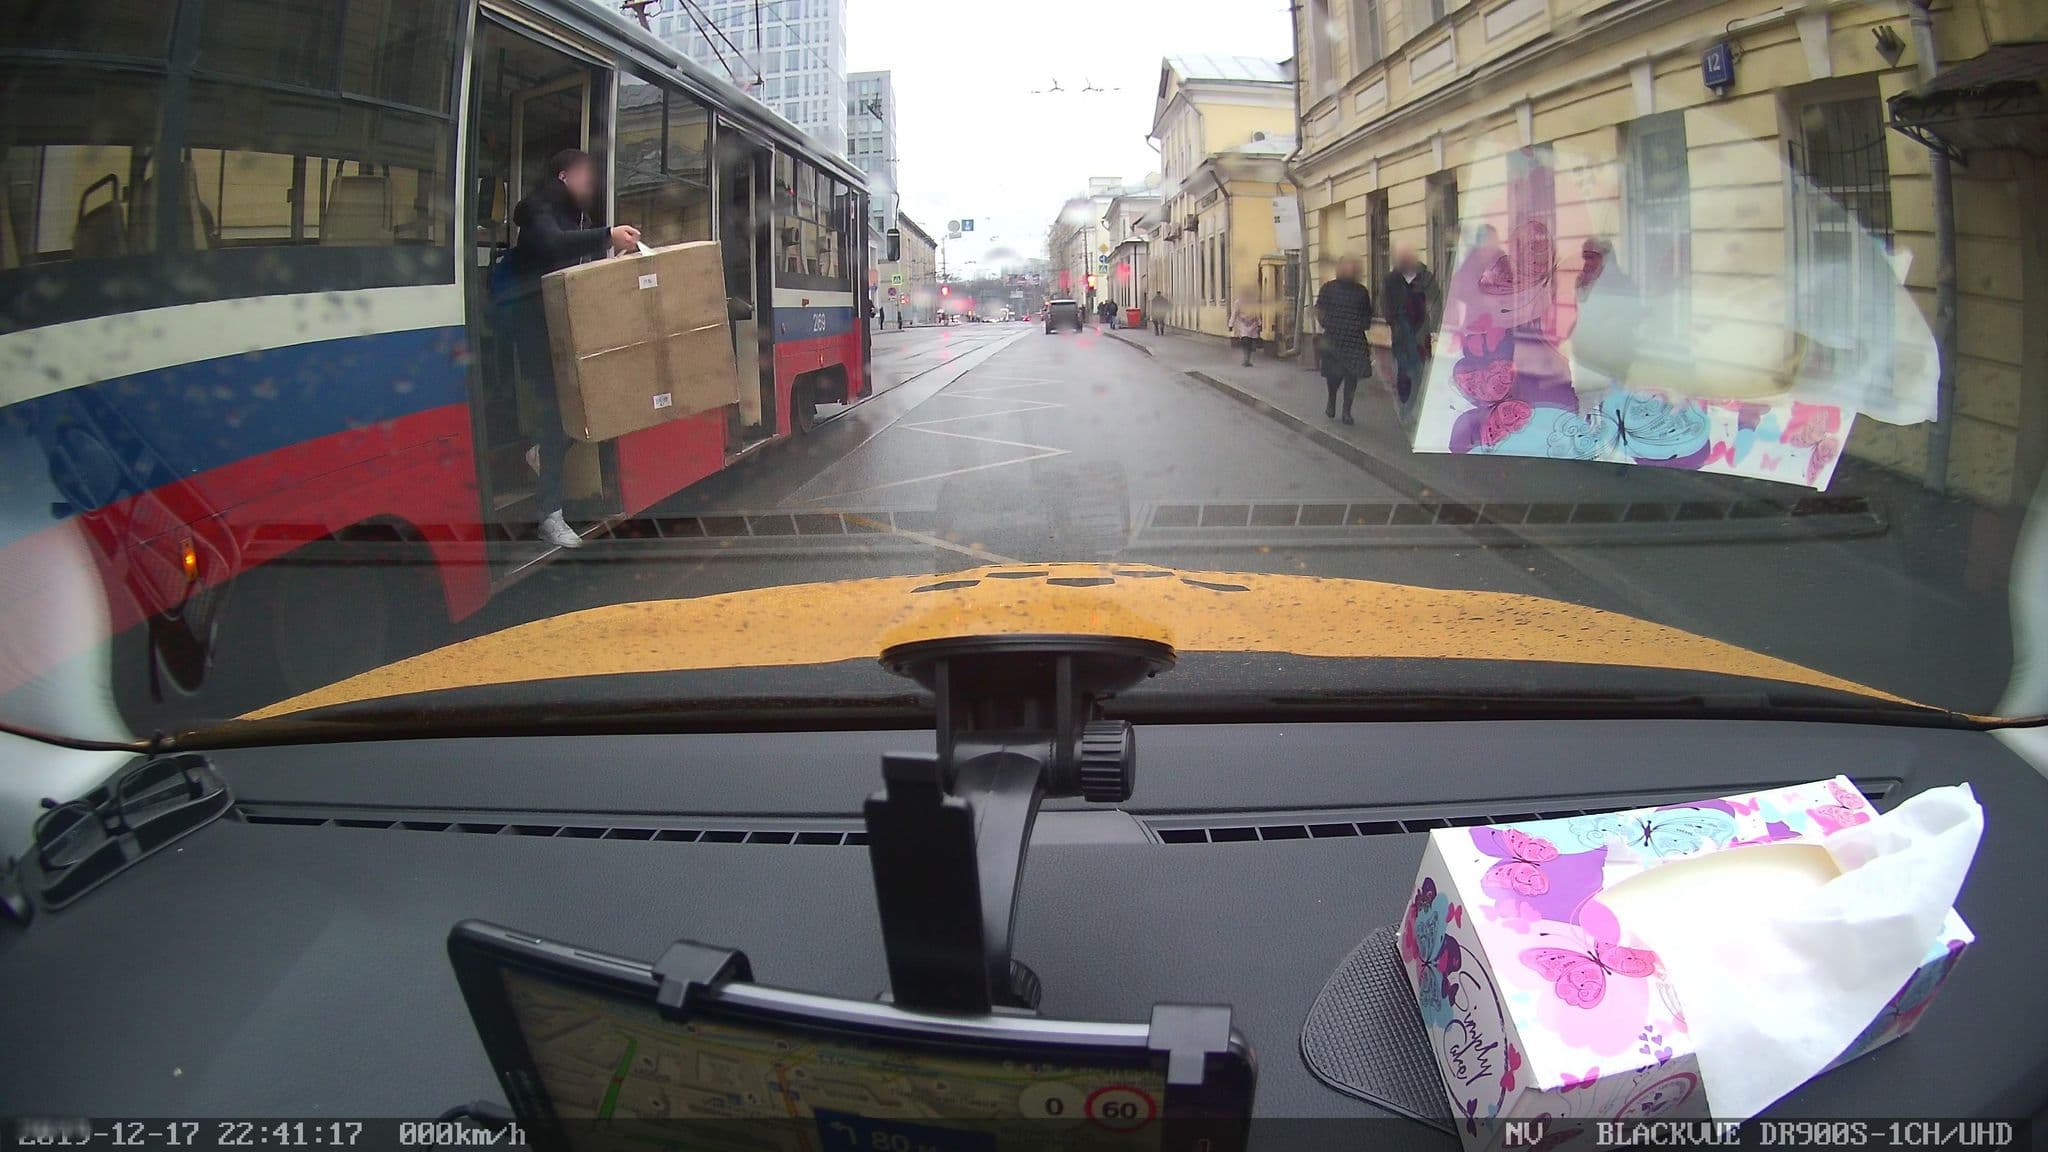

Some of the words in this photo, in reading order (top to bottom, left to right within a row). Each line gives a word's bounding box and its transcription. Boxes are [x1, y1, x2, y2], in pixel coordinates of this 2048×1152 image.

[1707, 53, 1721, 72] 12
[1454, 970, 1498, 1086] Simply
[1443, 1019, 1468, 1080] Care
[1045, 1097, 1064, 1116] 0
[1102, 1101, 1138, 1119] 60
[871, 1130, 912, 1152] 80
